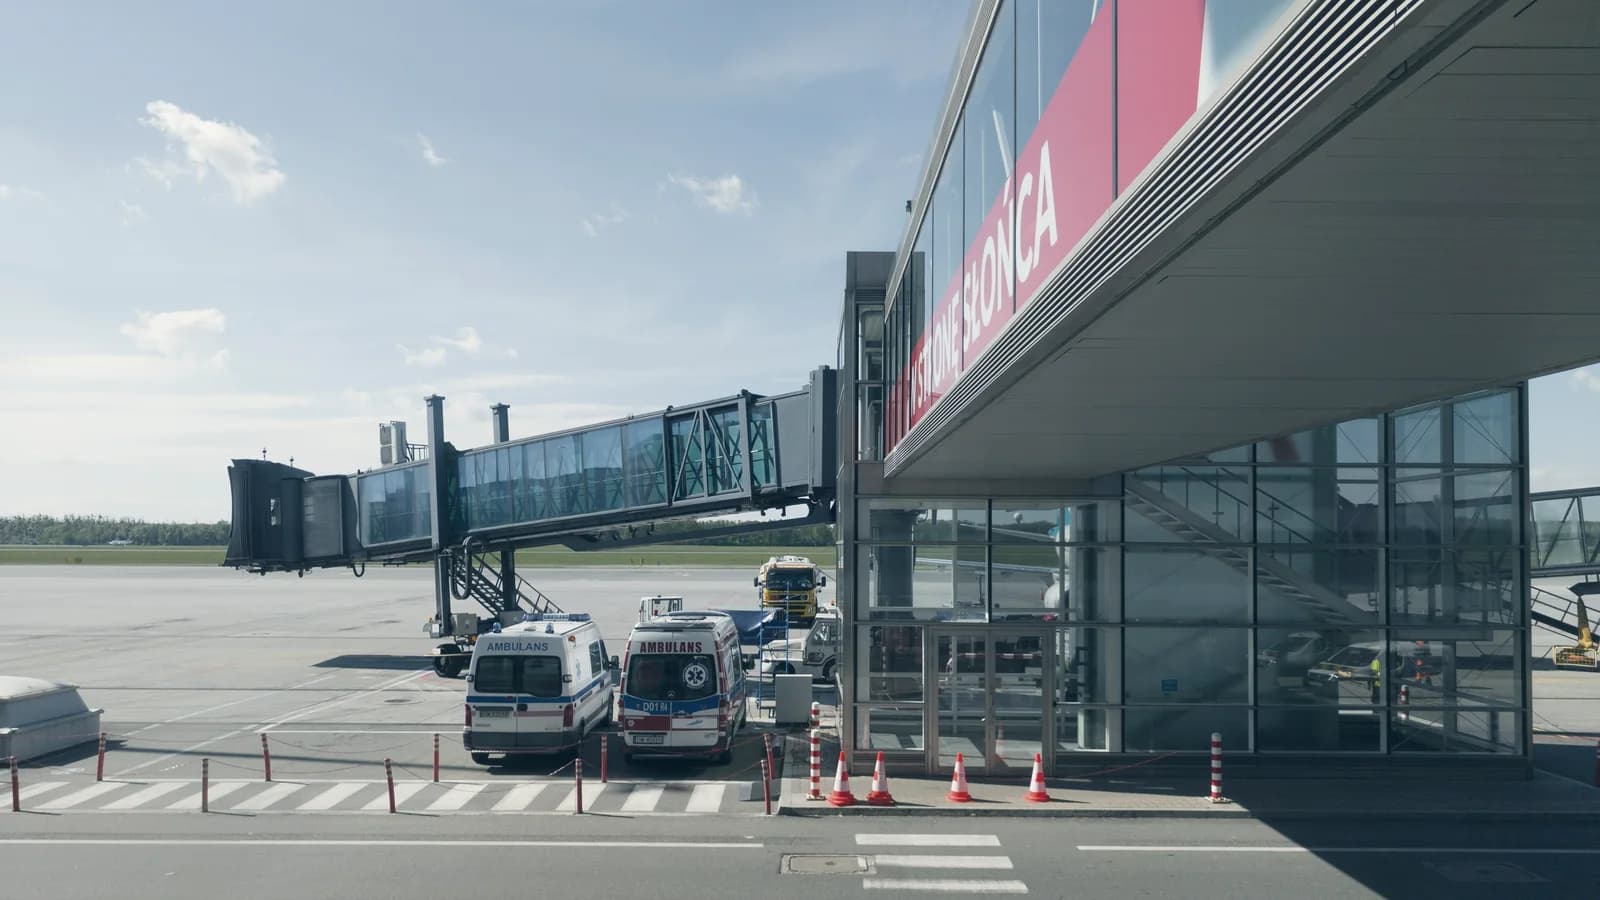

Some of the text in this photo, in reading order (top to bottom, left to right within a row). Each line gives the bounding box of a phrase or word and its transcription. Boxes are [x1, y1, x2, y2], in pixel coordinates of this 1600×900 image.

[963, 140, 1058, 353] SŁOŃCA
[487, 642, 549, 652] AMBULANS
[639, 641, 703, 654] AMBULANS
